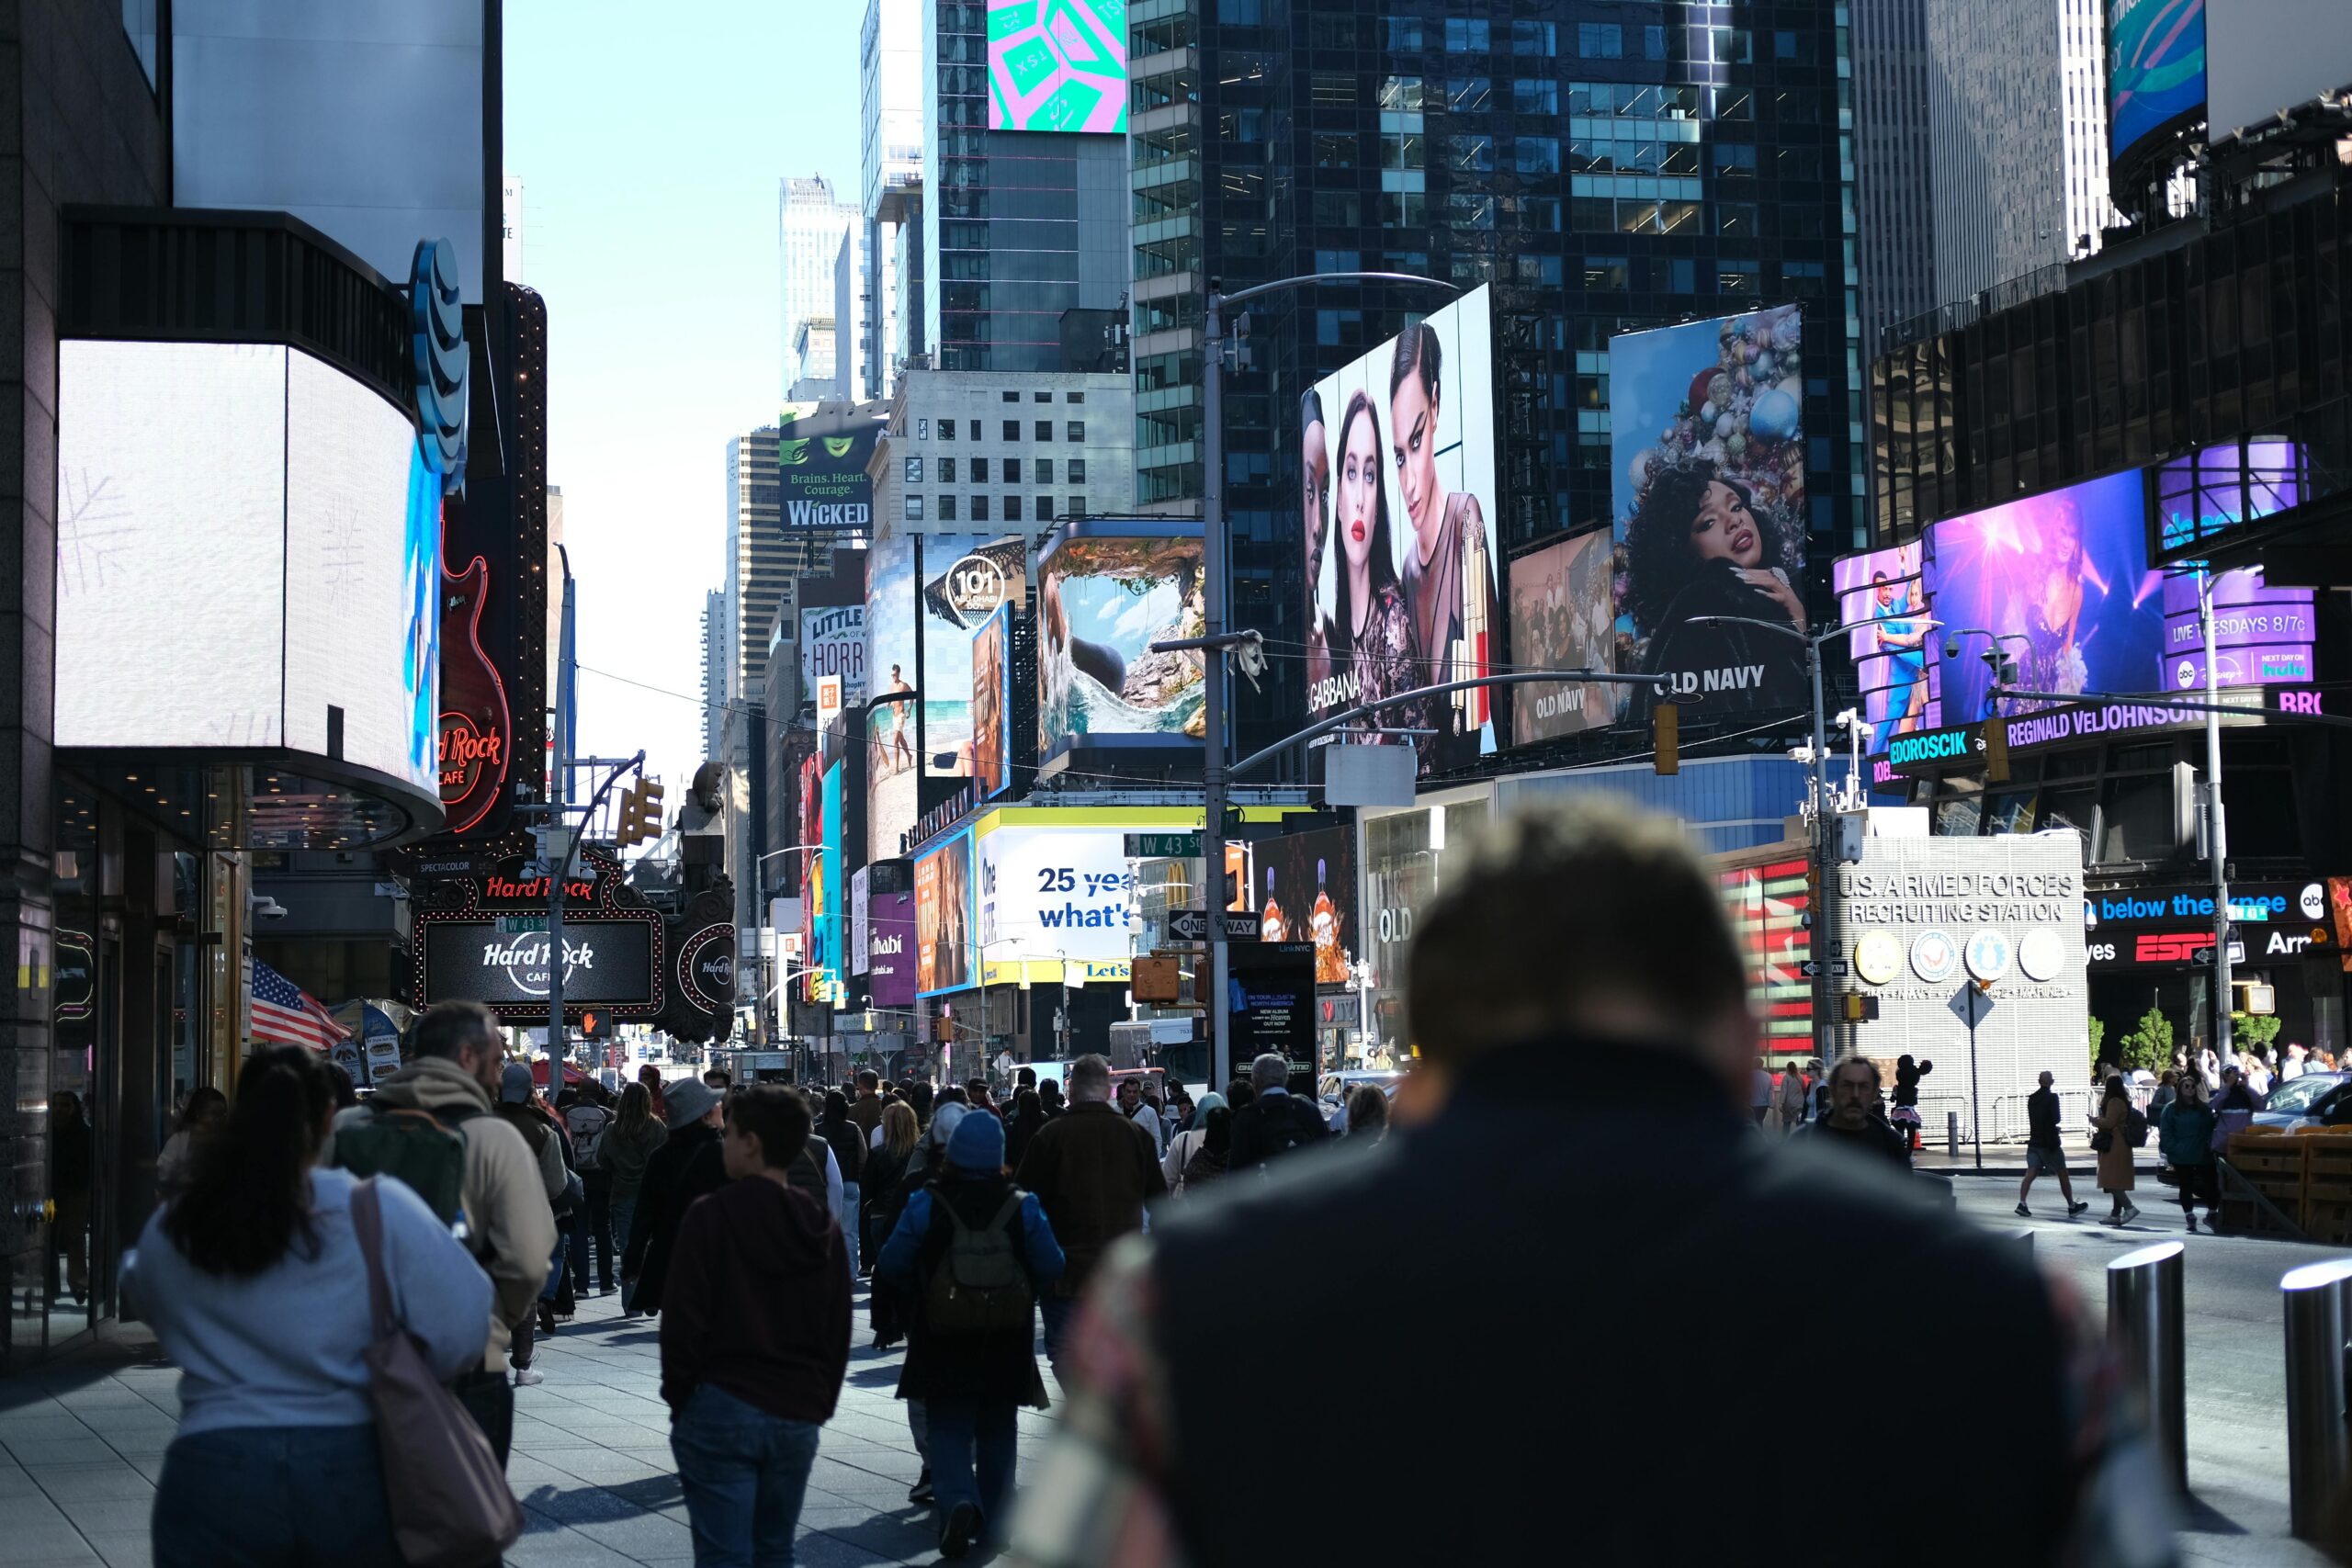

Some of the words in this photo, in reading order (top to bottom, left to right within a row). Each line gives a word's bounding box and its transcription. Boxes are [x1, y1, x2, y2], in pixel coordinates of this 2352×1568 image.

[790, 474, 830, 484] Brains.
[832, 473, 867, 483] Heart.
[805, 485, 854, 497] Courage.
[956, 570, 993, 593] 101
[813, 609, 862, 640] LITTLE
[2173, 624, 2194, 643] LIVE
[2195, 617, 2268, 638] TESDAYS
[2273, 615, 2306, 633] 8/7c
[813, 642, 864, 679] HORR
[2263, 662, 2307, 677] hulu
[1703, 664, 1765, 692] NAVY
[1310, 669, 1362, 713] GABBANA
[1536, 695, 1556, 719] OLD
[1557, 688, 1587, 714] NAVY
[2007, 713, 2070, 747] REGINALD
[451, 727, 501, 767] Rock
[1143, 837, 1157, 854] W
[1165, 837, 1182, 854] 43
[1190, 837, 1201, 848] St
[421, 862, 469, 872] SPECTACOLOR
[982, 857, 996, 897] One
[486, 876, 541, 897] Hard
[1038, 868, 1075, 892] 25
[1838, 873, 1877, 897] U.S.
[1883, 873, 1975, 897] ARMED
[1978, 873, 2074, 897] FORCES
[1038, 902, 1129, 928] what's
[1850, 902, 1974, 922] RECRUITING
[1979, 902, 2064, 922] STATION
[2102, 897, 2165, 919] below
[2172, 895, 2215, 916] the
[508, 921, 517, 931] W
[522, 920, 534, 931] 43
[1181, 919, 1206, 932] ONE
[1379, 907, 1412, 943] OLD
[483, 943, 539, 966] Hard
[2136, 932, 2216, 962] ESP
[526, 972, 550, 983] CAF
[702, 963, 724, 973] Hard
[1087, 963, 1129, 977] Let's
